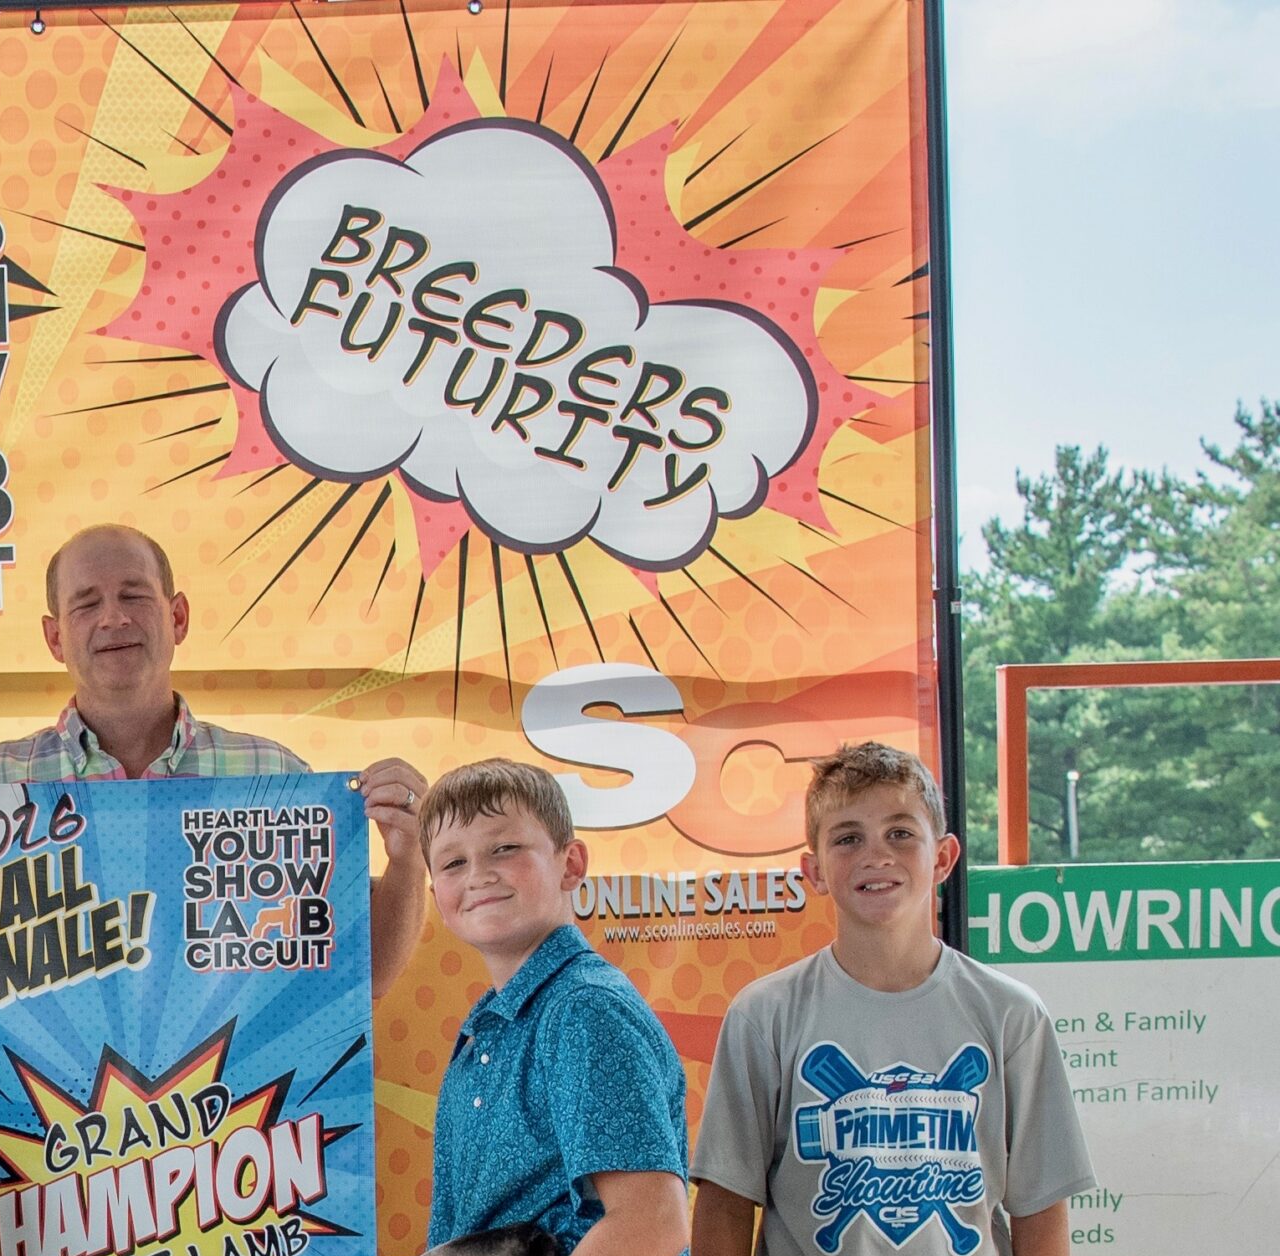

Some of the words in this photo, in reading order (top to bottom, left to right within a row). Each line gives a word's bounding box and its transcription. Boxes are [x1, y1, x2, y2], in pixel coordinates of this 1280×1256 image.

[321, 203, 732, 451] BREEDERS
[290, 266, 711, 510] FUTURITY
[183, 805, 333, 832] HEARTLAND
[184, 827, 333, 864] YOUTH
[184, 858, 334, 901] SHOW
[572, 870, 696, 920] ONLINE
[703, 867, 807, 915] SALES
[604, 917, 777, 943] www.sconlinesales.com
[968, 886, 1280, 954] HOWRIN
[185, 937, 334, 971] CIRCUIT
[1095, 1012, 1115, 1032] &
[1125, 1009, 1207, 1034] Family
[1072, 1087, 1127, 1104] man
[1136, 1079, 1219, 1104] Family
[44, 1081, 232, 1174] GRAND
[833, 1106, 977, 1152] PRIMETIM
[813, 1158, 985, 1216] Showtime
[1070, 1188, 1123, 1212] mily
[1070, 1223, 1115, 1245] eds
